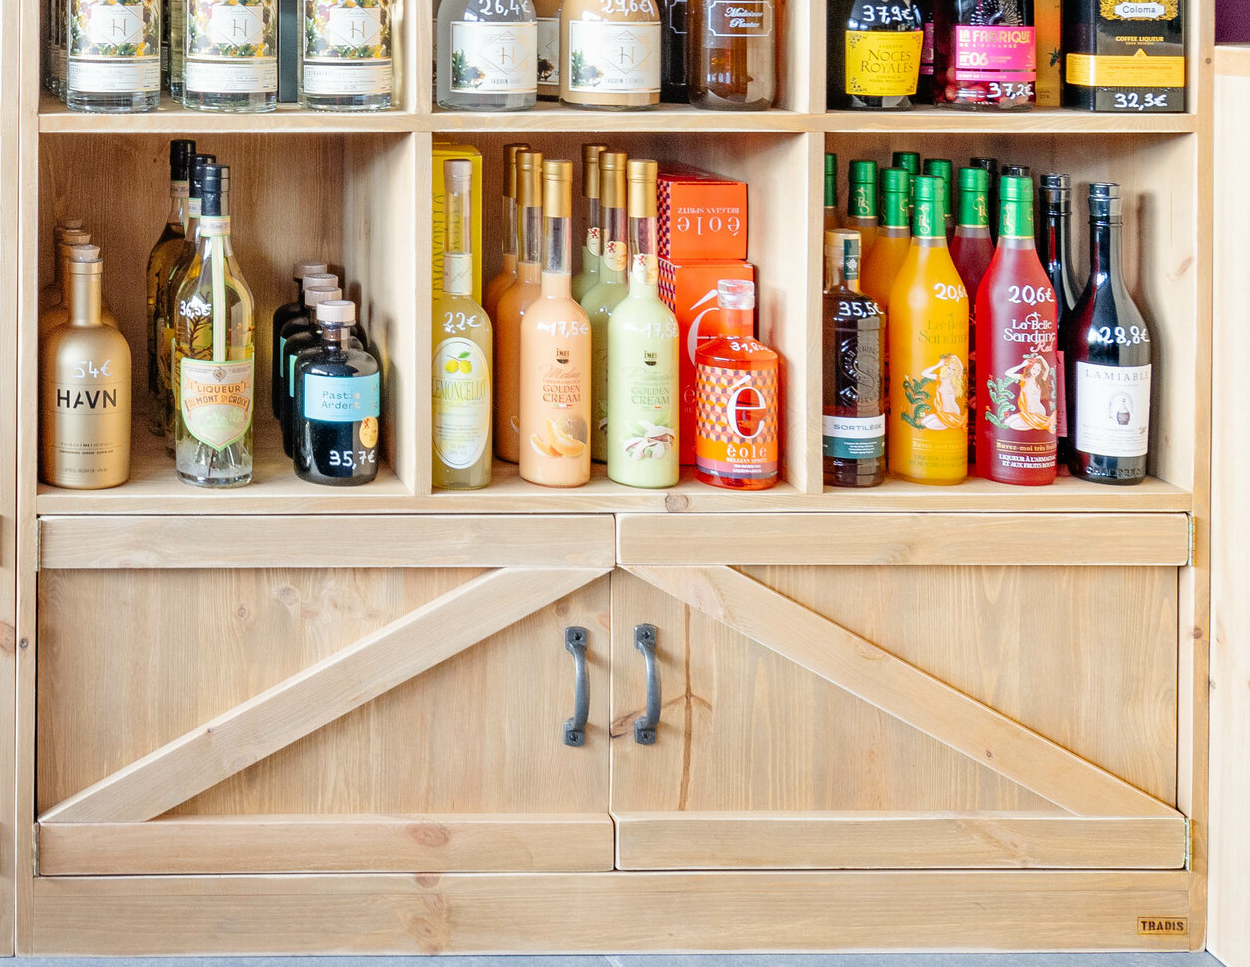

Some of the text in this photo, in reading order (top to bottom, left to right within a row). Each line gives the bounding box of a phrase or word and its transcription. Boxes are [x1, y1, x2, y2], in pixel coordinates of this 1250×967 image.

[862, 5, 914, 25] 37,9€
[1122, 5, 1156, 14] Coloma
[972, 29, 1031, 44] FABRIQUE
[868, 49, 911, 61] NOCES
[860, 61, 914, 74] ROYALES
[1114, 92, 1168, 110] 32,3€
[1008, 285, 1055, 306] 20,6€
[1012, 320, 1028, 330] La
[71, 358, 112, 379] 54€
[198, 385, 241, 393] LIQUEUR
[542, 385, 581, 393] GOLDEN
[631, 387, 670, 395] GOLDEN
[56, 389, 118, 409] HAVN
[196, 395, 248, 407] MONT CROIX
[542, 393, 581, 403] CREAM
[631, 395, 670, 405] CREAM
[726, 375, 766, 439] é
[328, 450, 376, 470] 35,7€
[1140, 921, 1184, 931] TRADIS
